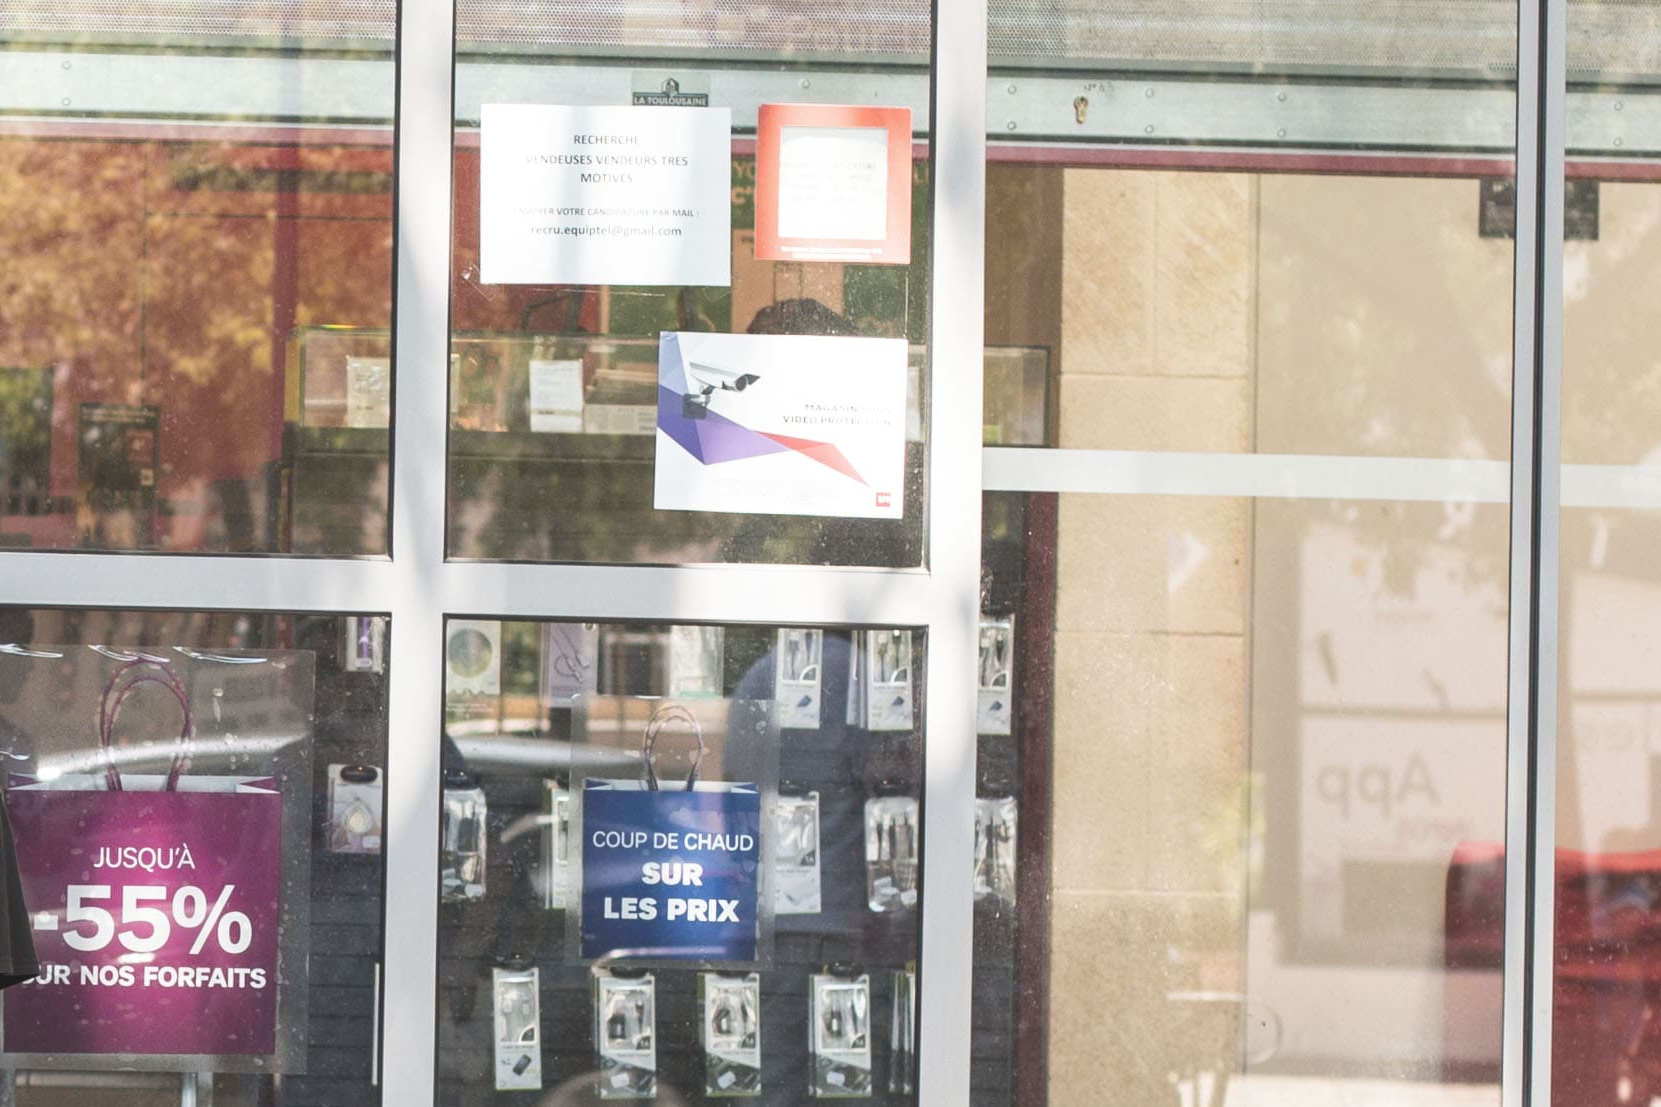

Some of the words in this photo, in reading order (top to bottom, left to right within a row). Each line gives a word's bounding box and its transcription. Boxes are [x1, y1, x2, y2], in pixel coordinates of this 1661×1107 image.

[573, 135, 640, 145] RECHERCHE
[595, 155, 658, 166] VENDEURS
[556, 207, 585, 216] VOTRE
[592, 830, 648, 849] COUP
[653, 832, 679, 850] DE
[684, 833, 754, 852] CHAUD
[93, 843, 196, 873] JUSQU'À
[641, 861, 703, 887] SUR
[33, 884, 253, 955] -55%
[603, 896, 658, 921] LES
[667, 898, 740, 923] PRIX
[22, 964, 71, 985] UR
[80, 965, 135, 987] NOS
[143, 966, 267, 989] FORFAITS
